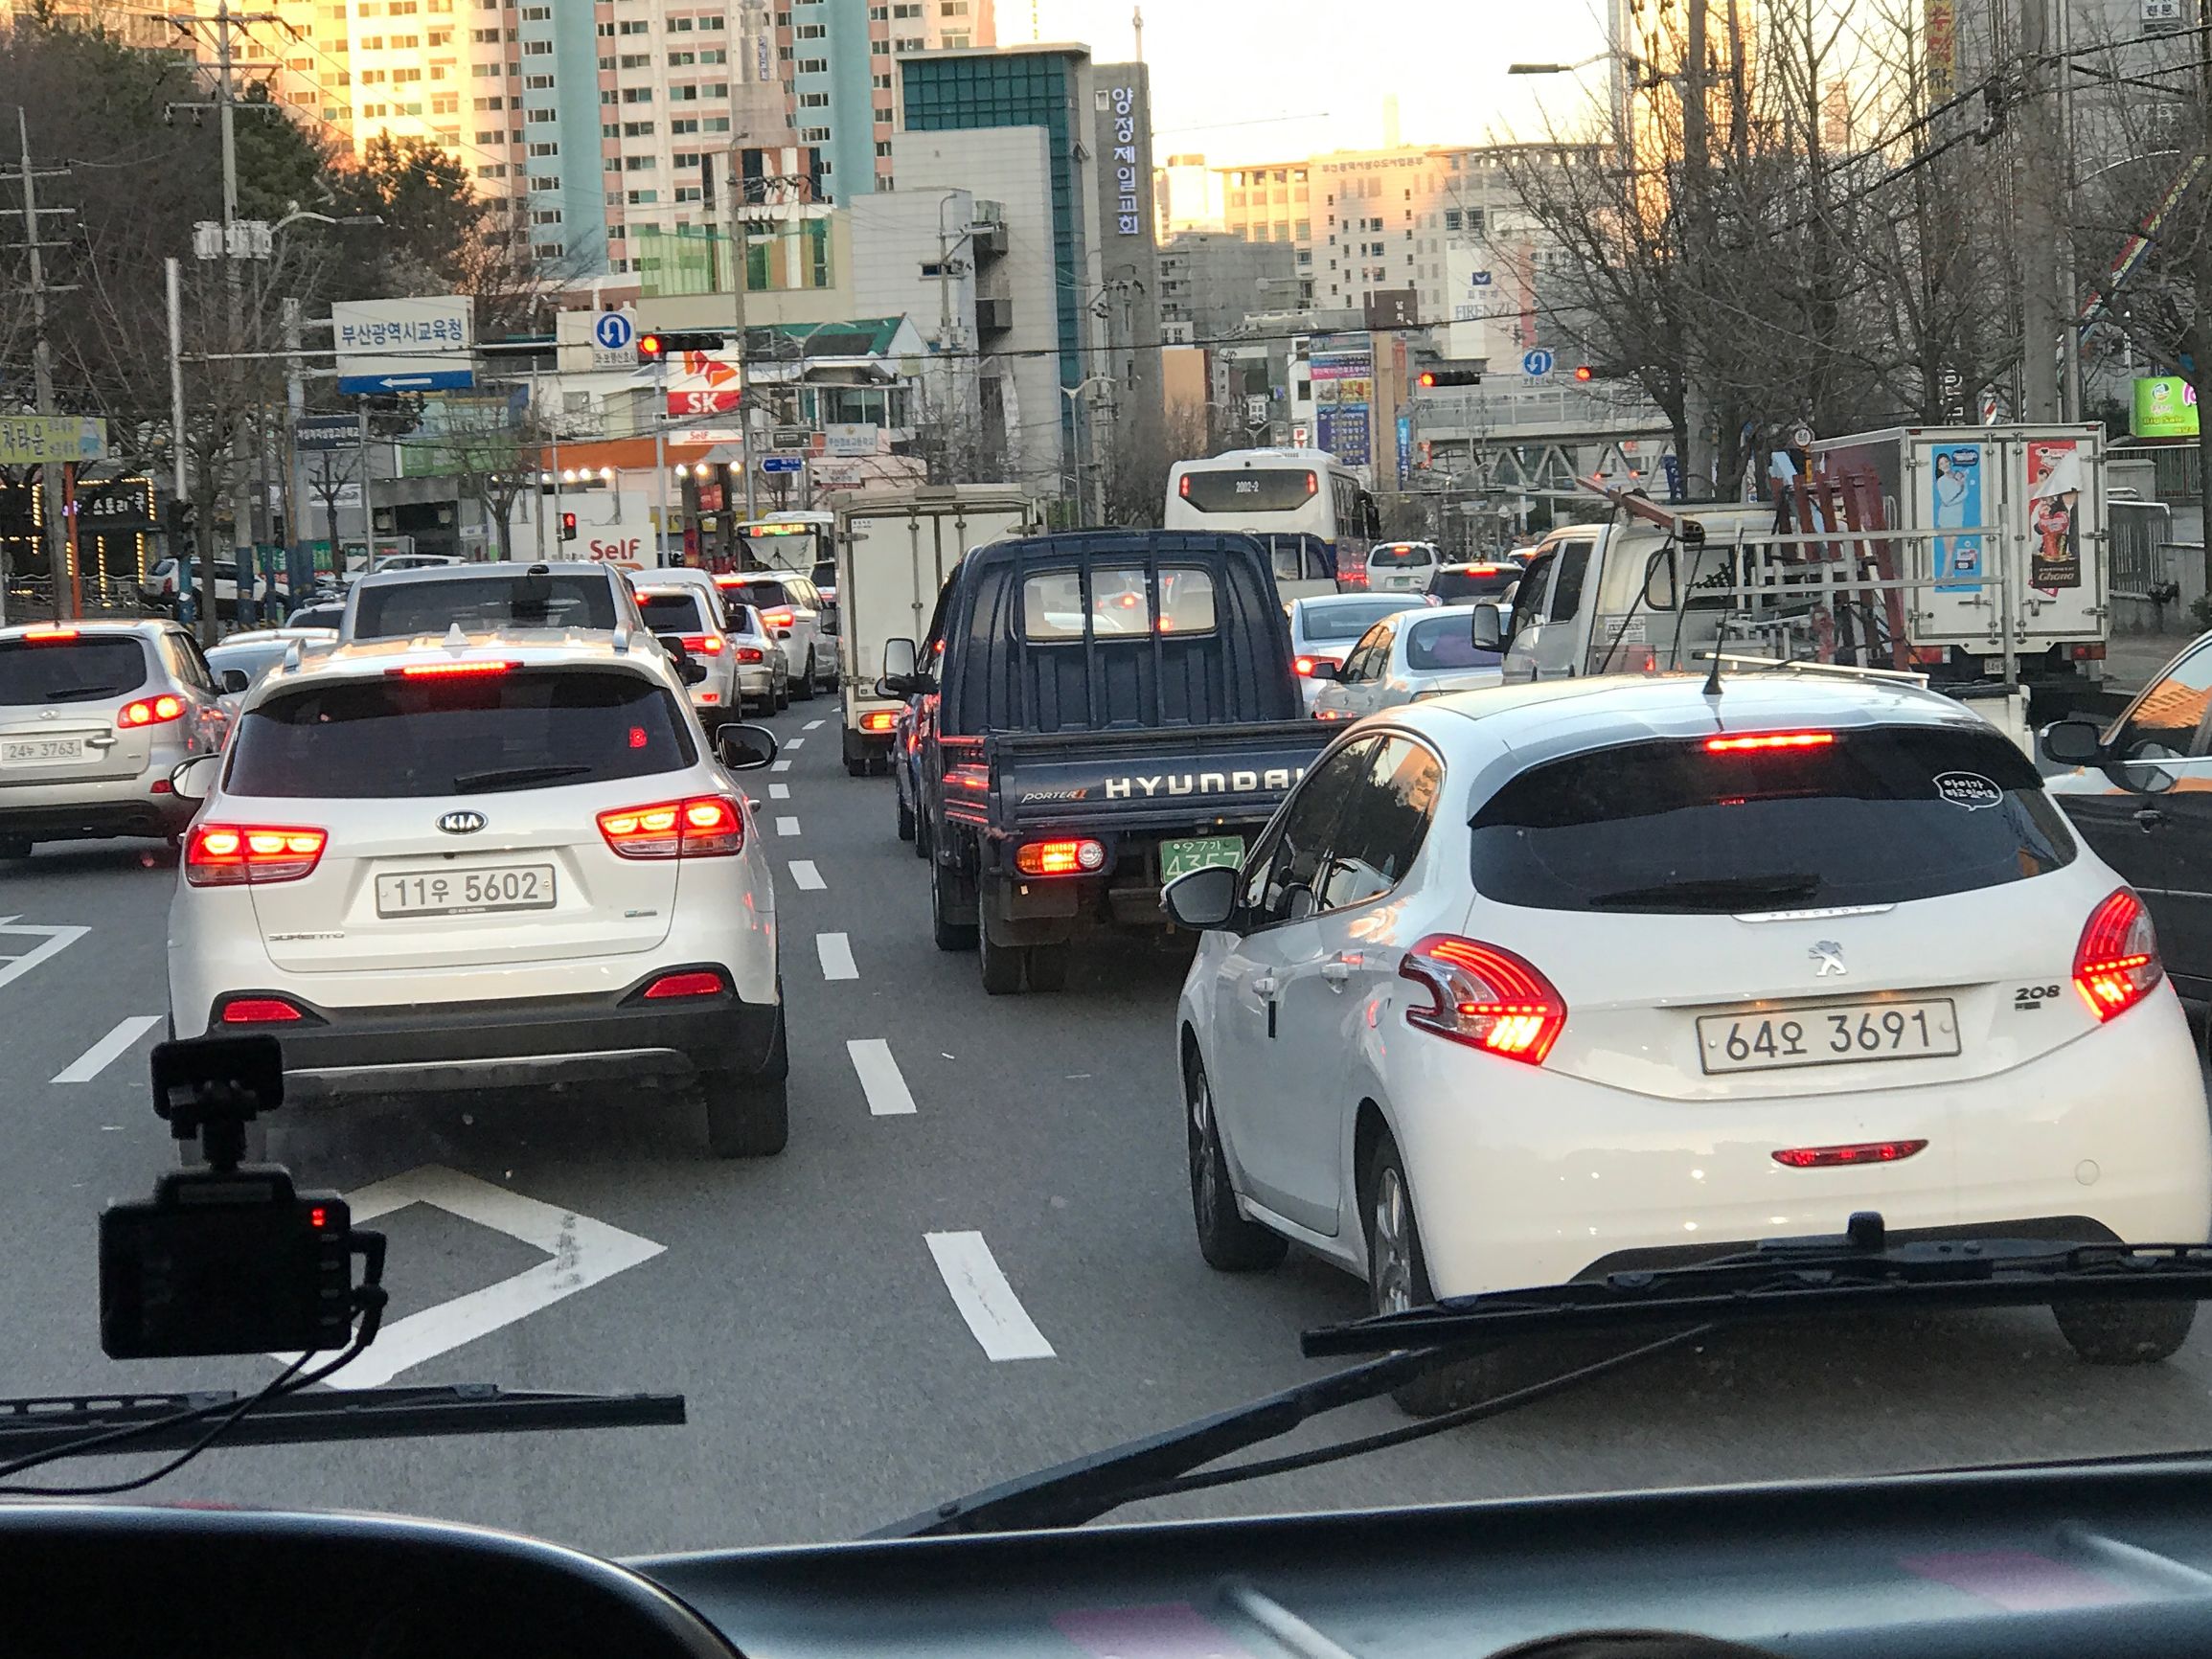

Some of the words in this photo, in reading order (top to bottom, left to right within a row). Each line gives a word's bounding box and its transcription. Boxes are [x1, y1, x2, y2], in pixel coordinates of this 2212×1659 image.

[1112, 86, 1139, 235] 양정제일교회
[342, 318, 462, 346] 부산광역시교육청
[687, 392, 720, 413] SK
[590, 538, 641, 560] Self
[40, 742, 75, 757] 3763
[445, 814, 482, 830] KIA
[1182, 840, 1221, 852] 97가
[394, 878, 449, 907] 11우
[465, 872, 538, 901] 5602
[2014, 985, 2062, 1001] 208
[1725, 1019, 1808, 1060] 64오
[1827, 1009, 1929, 1053] 3691
